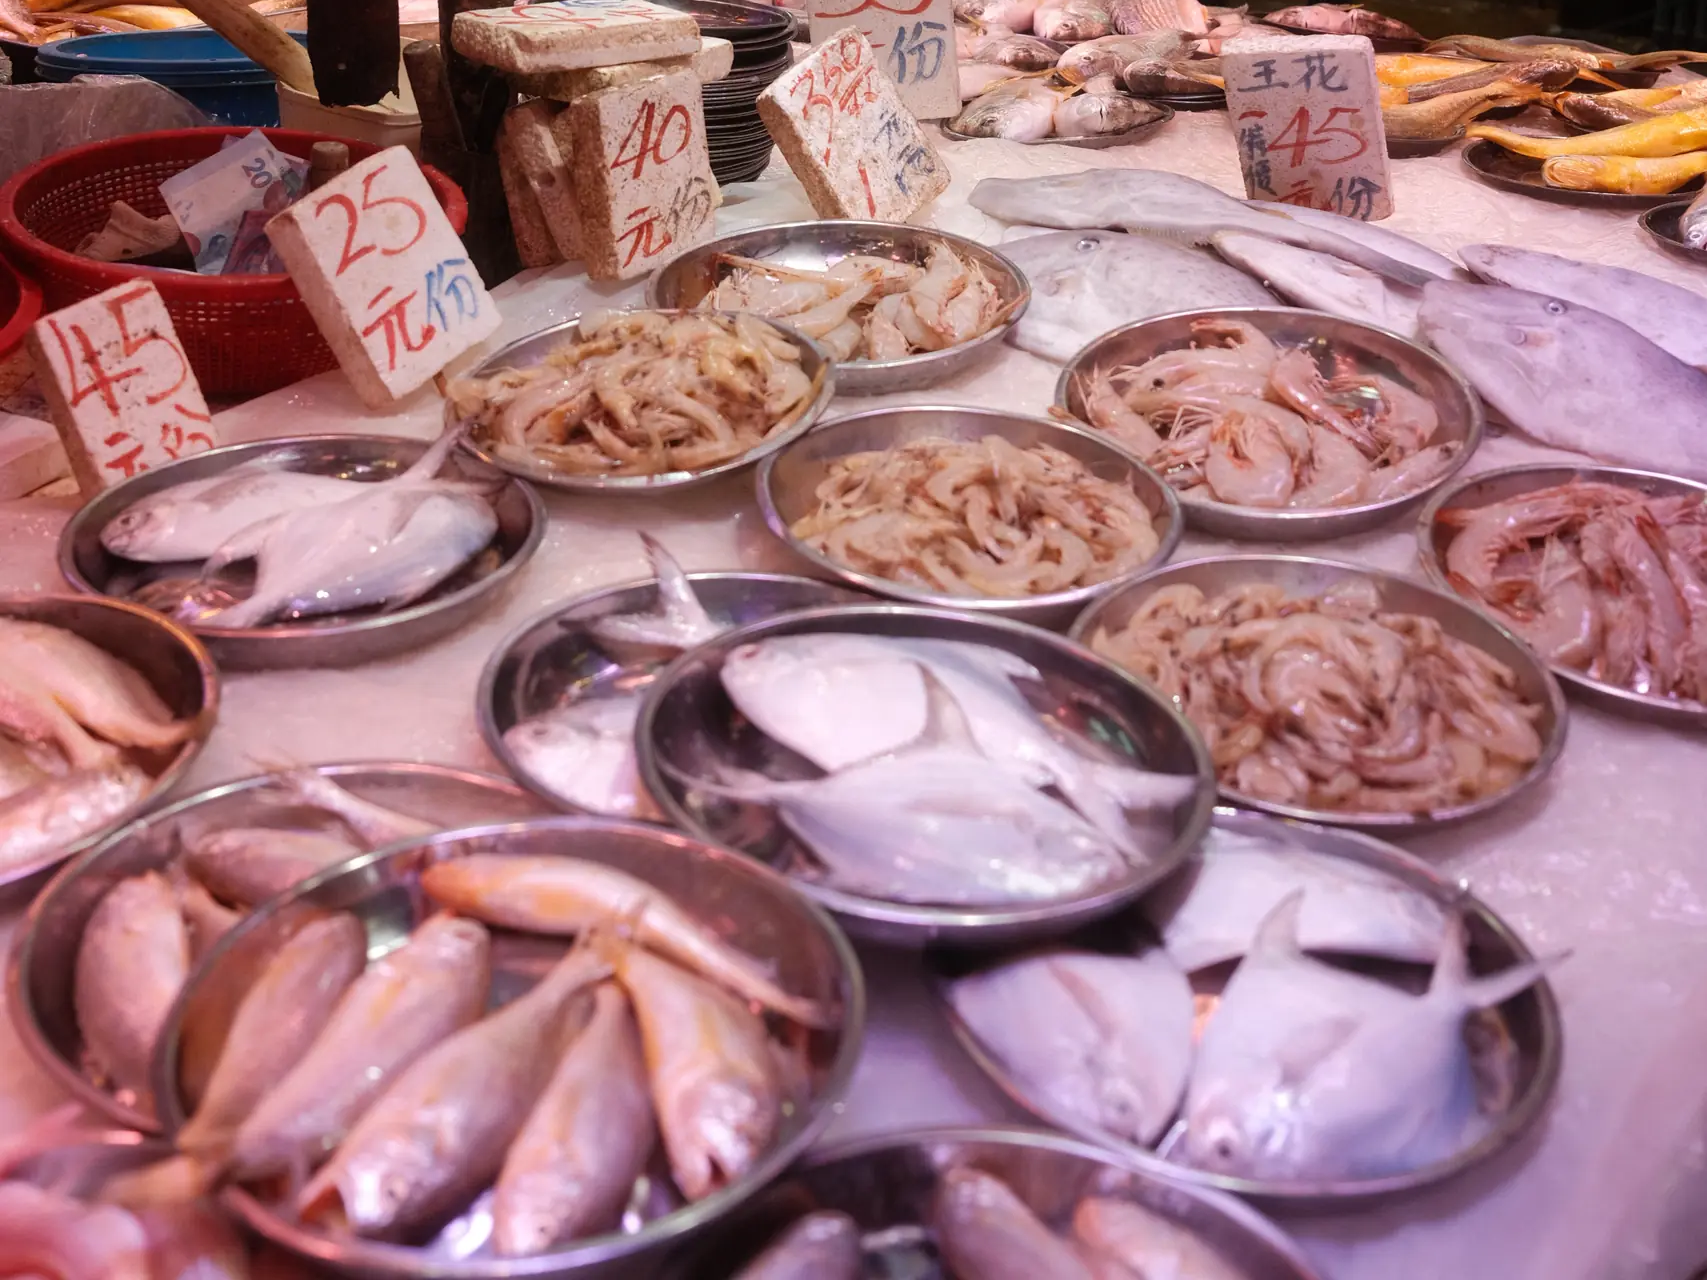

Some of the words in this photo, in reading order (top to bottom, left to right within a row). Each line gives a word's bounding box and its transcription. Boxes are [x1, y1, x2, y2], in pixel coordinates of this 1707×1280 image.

[1237, 52, 1348, 93] 王花
[241, 157, 273, 189] 20
[611, 98, 693, 180] 40
[1267, 106, 1369, 169] 45
[315, 164, 427, 277] 25
[47, 285, 189, 417] 45
